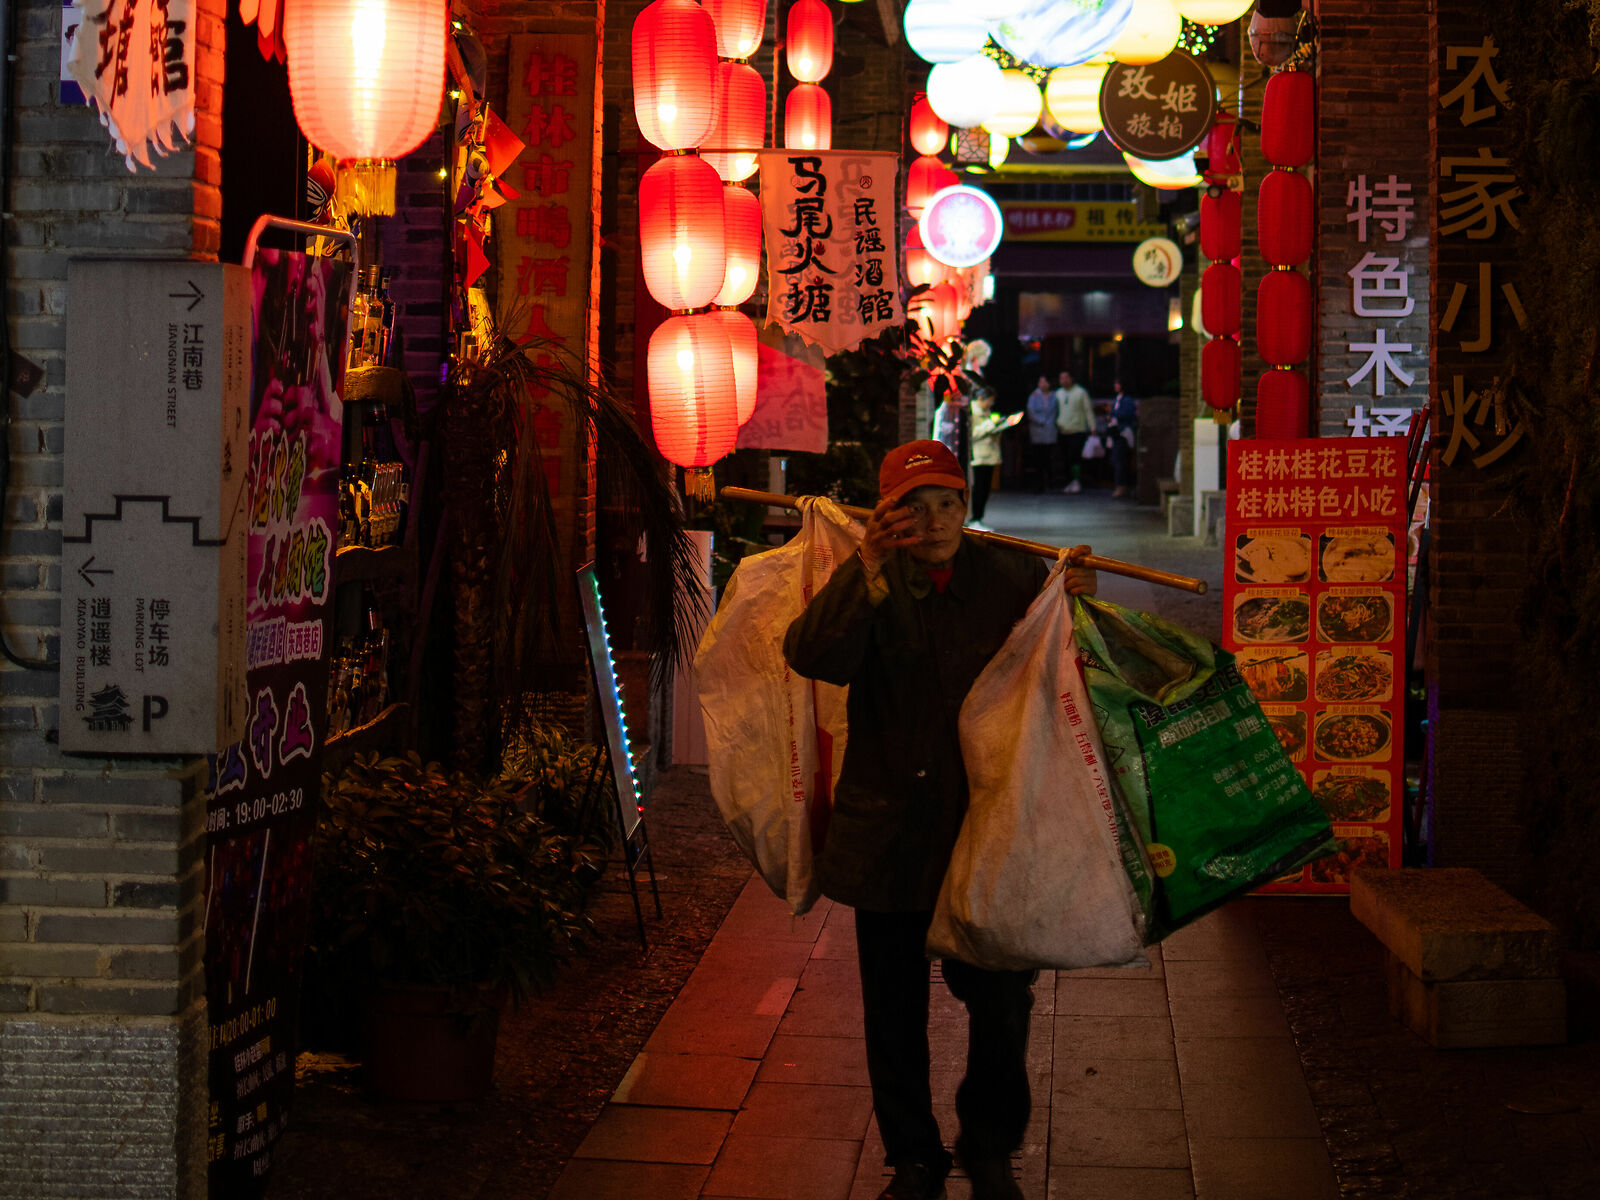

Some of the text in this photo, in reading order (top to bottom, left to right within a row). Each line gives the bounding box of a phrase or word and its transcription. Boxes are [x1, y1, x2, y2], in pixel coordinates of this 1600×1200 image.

[1117, 66, 1197, 113] 玫姬
[1127, 112, 1183, 140] 旅拍
[778, 157, 838, 324] 马尾火塘
[1438, 35, 1527, 470] 农家小炒
[167, 323, 176, 428] JIANGNAN STREET
[182, 323, 204, 391] 江南巷
[1238, 447, 1397, 481] 桂林桂花豆花
[1237, 485, 1398, 519] 桂林特色小吃
[75, 598, 87, 711] XIAOYAO BUILDING
[90, 598, 112, 667] 逍遥楼
[135, 598, 145, 673] PARKING LOT
[148, 598, 170, 667] 停车场
[142, 695, 169, 733] P
[1060, 691, 1083, 727] 好面粉
[235, 787, 303, 825] 19:00-02:30
